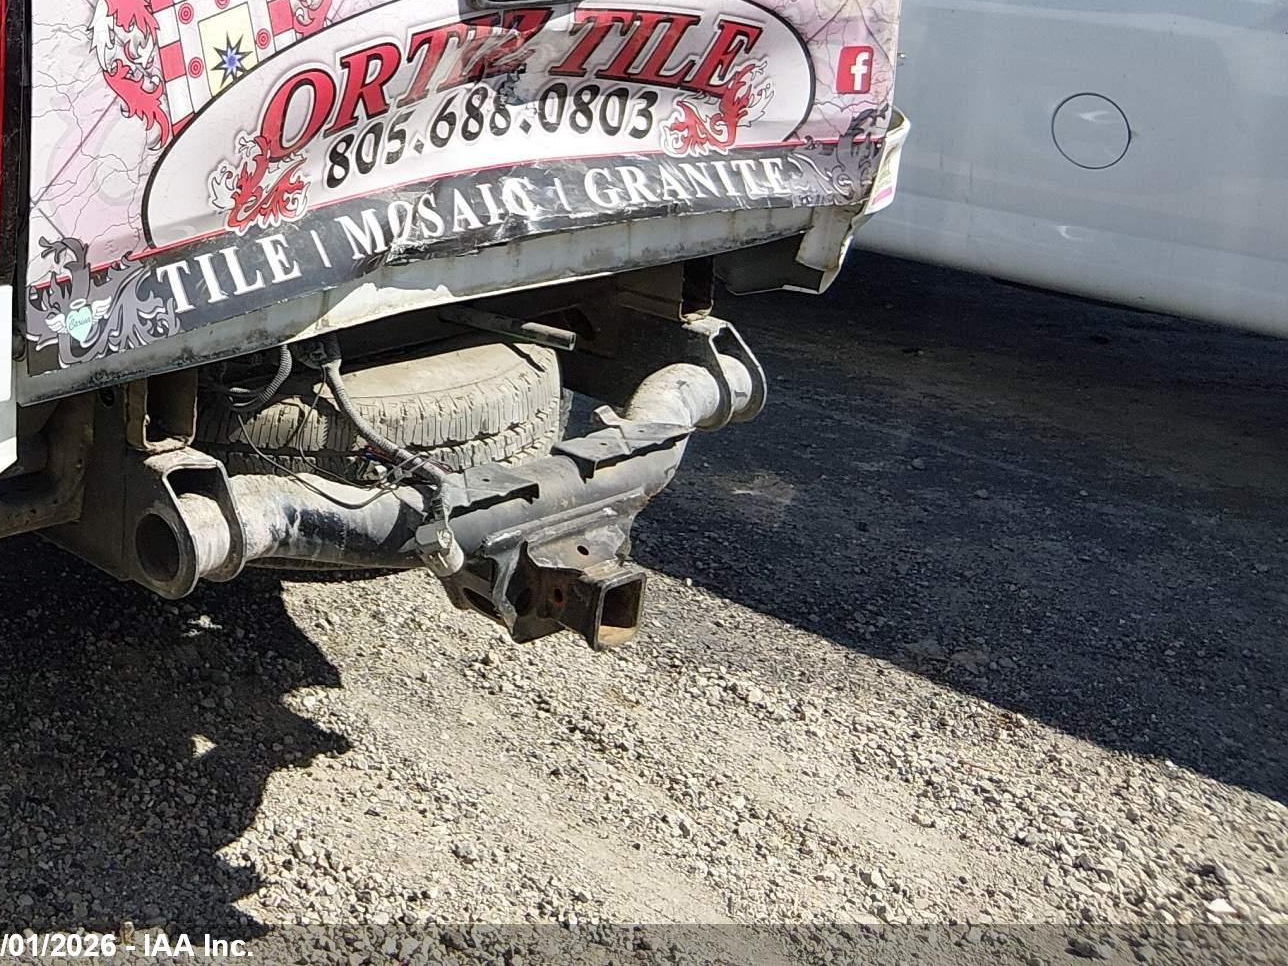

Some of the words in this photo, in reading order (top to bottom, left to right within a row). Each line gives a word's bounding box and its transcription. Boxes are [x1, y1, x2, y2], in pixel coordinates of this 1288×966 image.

[548, 7, 763, 99] TILE
[327, 83, 658, 188] 805.688.0803
[157, 233, 302, 313] TILE
[334, 177, 540, 259] MOSAIC
[584, 157, 792, 210] GRANITE
